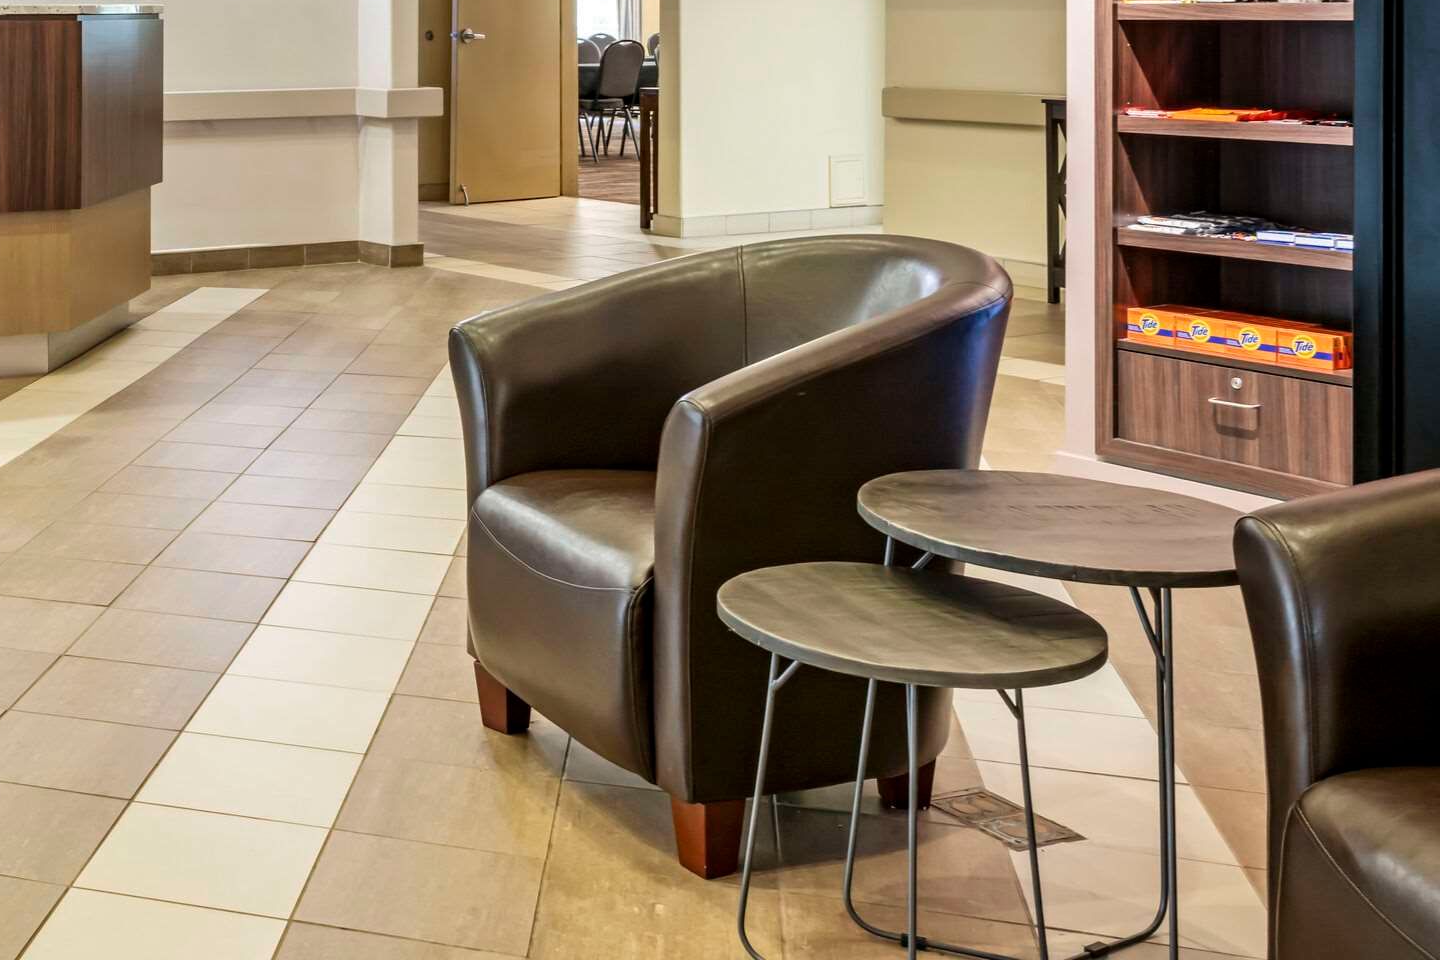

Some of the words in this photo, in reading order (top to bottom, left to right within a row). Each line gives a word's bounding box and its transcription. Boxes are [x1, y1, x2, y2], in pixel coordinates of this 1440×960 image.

[1140, 318, 1158, 330] Tide
[1190, 325, 1209, 338] Tide
[1239, 332, 1259, 346] Tide
[1294, 340, 1314, 353] Tide
